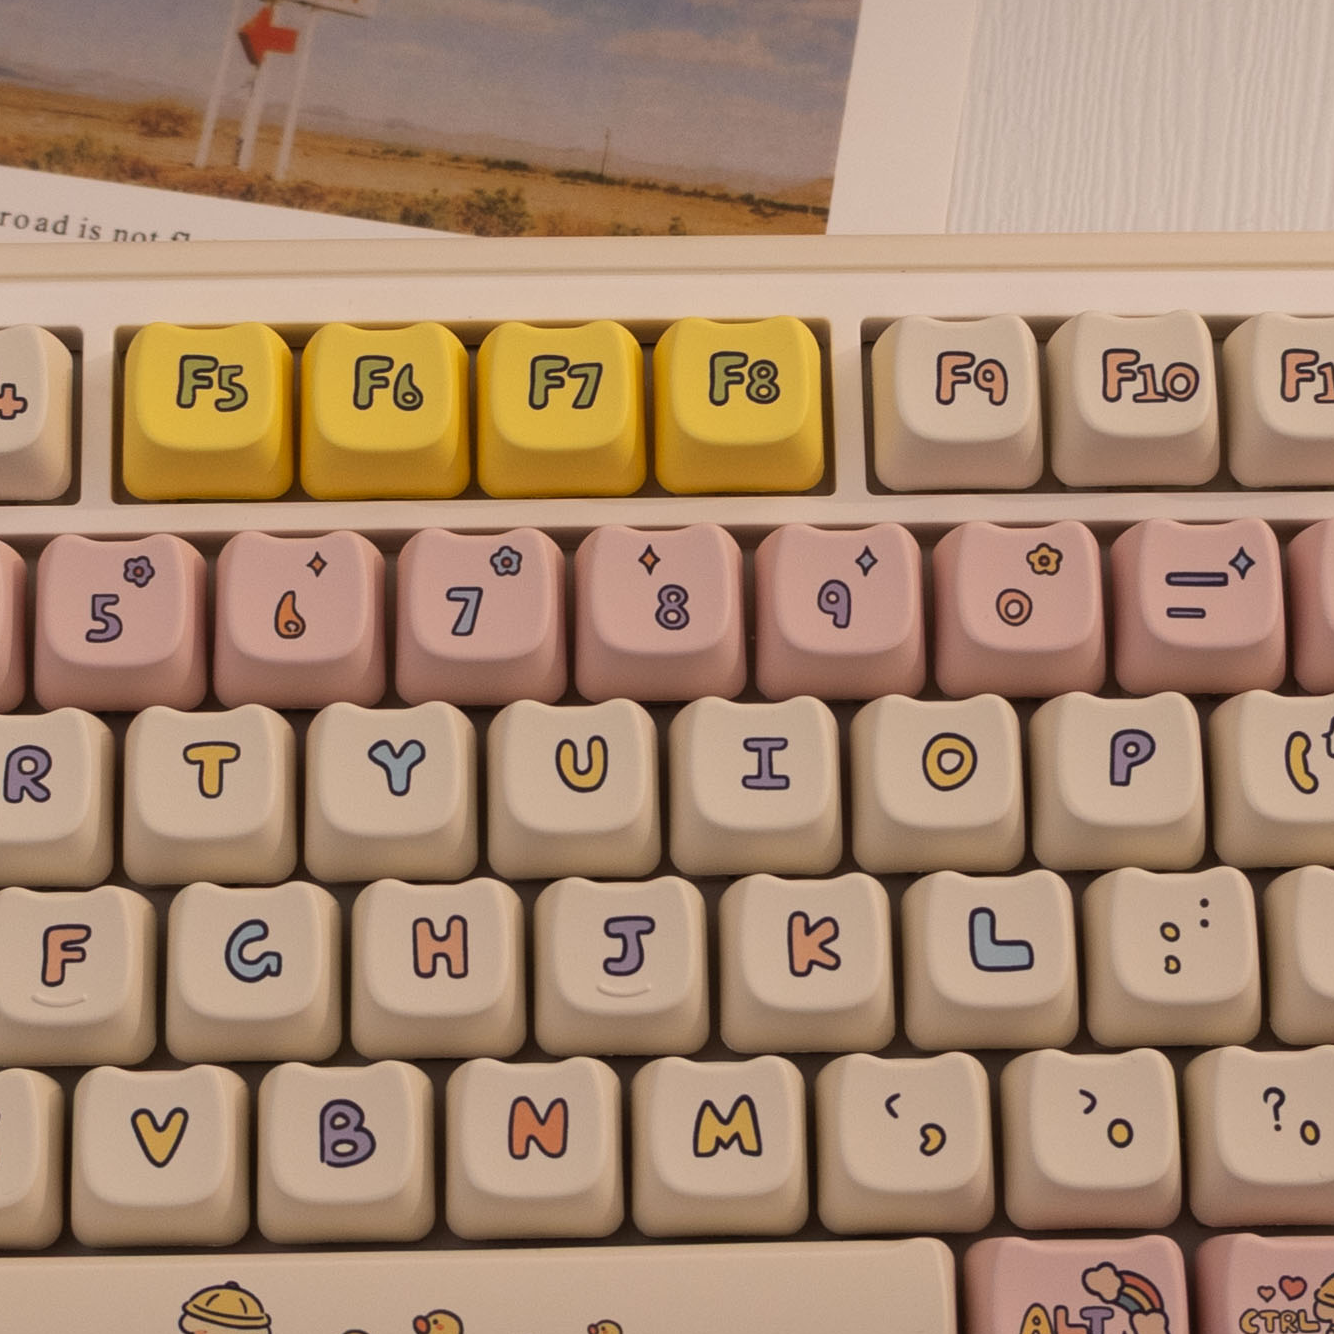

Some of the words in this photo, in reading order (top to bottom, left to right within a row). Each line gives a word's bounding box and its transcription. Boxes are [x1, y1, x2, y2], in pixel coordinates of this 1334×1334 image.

[78, 217, 102, 241] is
[176, 354, 249, 413] F5
[352, 354, 424, 412] F6
[528, 354, 604, 411] F7
[708, 350, 781, 407] F8
[935, 350, 1009, 407] F9
[1102, 348, 1200, 404] F10
[85, 593, 123, 644] 5
[274, 590, 307, 640] 6
[445, 586, 484, 637] 7
[654, 583, 690, 631] 8
[817, 579, 852, 629] 9
[995, 588, 1033, 627] 0
[2, 744, 53, 804] R
[182, 741, 241, 799] T
[367, 739, 426, 797] Y
[555, 735, 609, 794] U
[741, 737, 791, 791] I
[921, 732, 978, 792] O
[1109, 728, 1156, 787] P
[41, 923, 92, 988] F
[224, 918, 283, 984] G
[412, 914, 469, 980] H
[602, 915, 656, 977] J
[787, 910, 842, 978] K
[968, 906, 1035, 973] L
[130, 1106, 189, 1169] V
[319, 1098, 377, 1169] B
[507, 1095, 569, 1161] N
[692, 1094, 763, 1158] M
